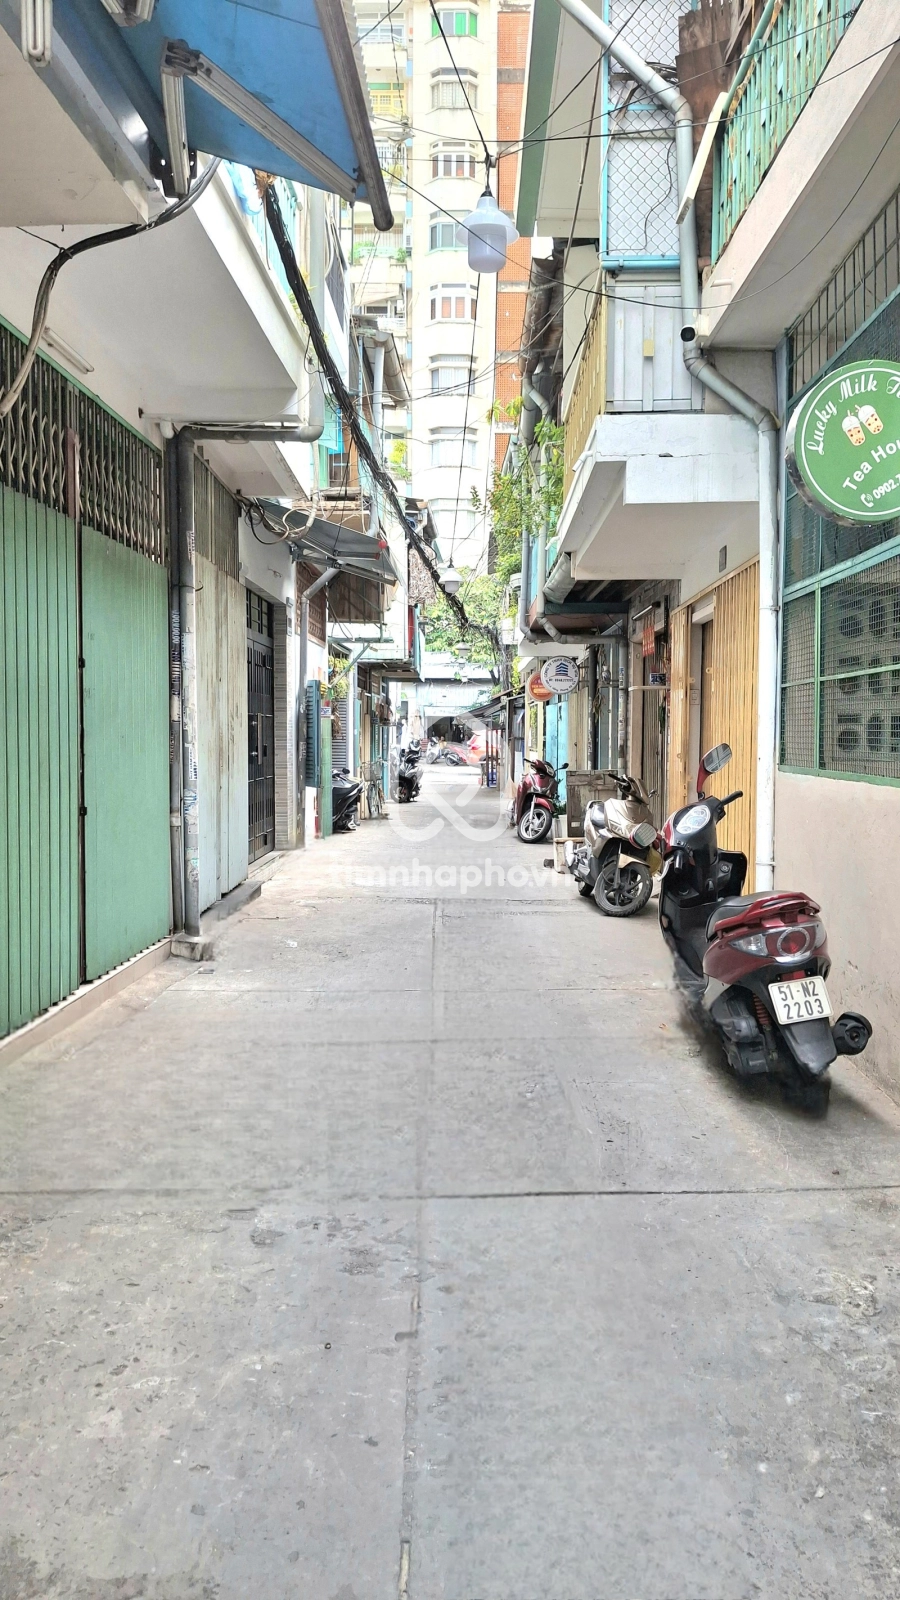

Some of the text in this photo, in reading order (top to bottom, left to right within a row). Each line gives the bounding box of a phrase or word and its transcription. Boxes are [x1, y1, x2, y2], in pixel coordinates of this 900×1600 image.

[806, 401, 838, 455] Lucky
[838, 373, 878, 403] Milk
[842, 461, 873, 490] Tea
[778, 981, 819, 1001] 51-N2
[784, 998, 824, 1019] 2203
